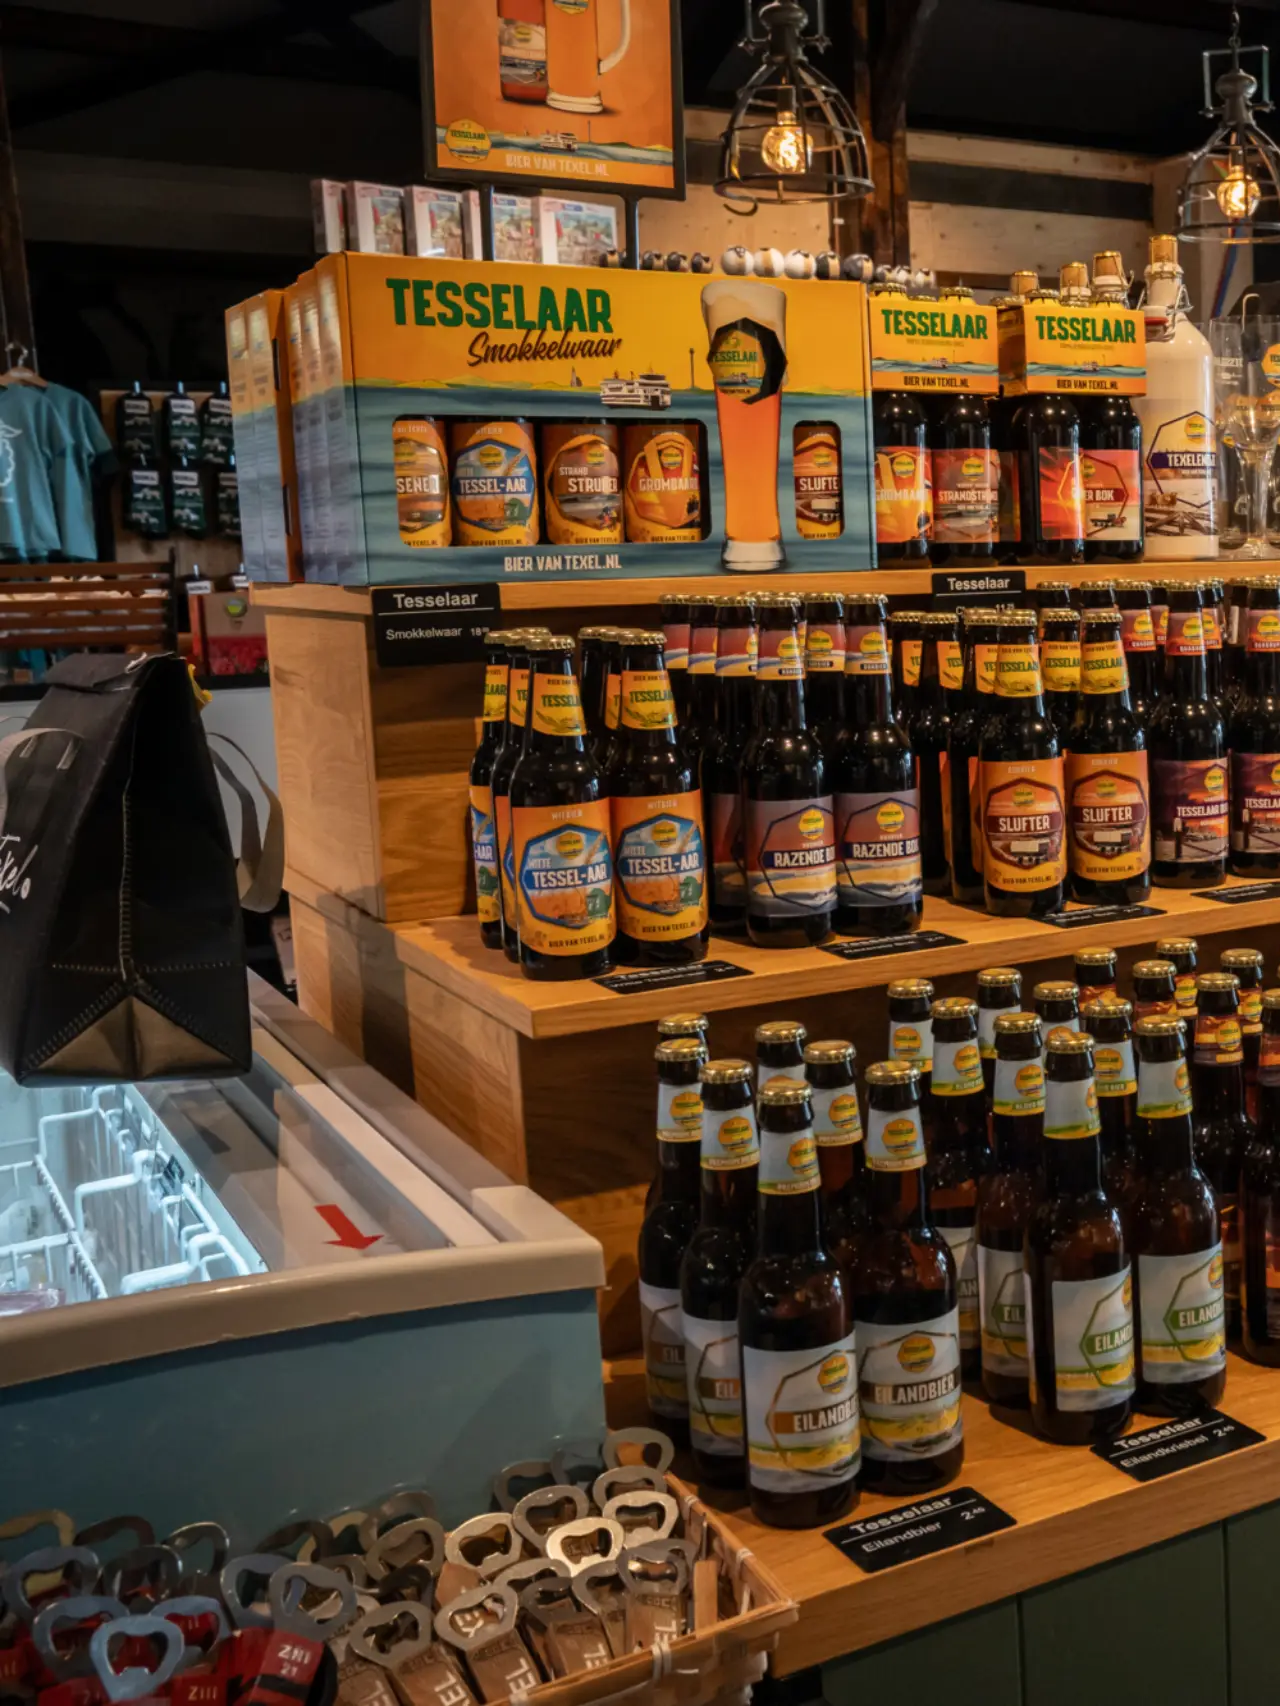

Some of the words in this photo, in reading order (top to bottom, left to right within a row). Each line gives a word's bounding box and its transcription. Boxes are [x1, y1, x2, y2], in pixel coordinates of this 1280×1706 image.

[505, 152, 532, 169] BIER
[534, 155, 558, 172] VAN
[559, 157, 610, 177] TEXEL.NL
[386, 278, 613, 333] TESSELAAR
[881, 309, 988, 340] TESSELAAR
[1036, 315, 1137, 343] TESSELAAR
[467, 327, 622, 367] Smokkelwaar
[904, 375, 920, 387] BIER
[921, 376, 936, 387] VAN
[937, 376, 970, 388] TEXEL.NL
[1057, 378, 1071, 389] BIER
[1073, 379, 1087, 390] VAN
[1088, 379, 1119, 391] TEXEL.NL
[459, 477, 527, 494] TESSEL-AAR
[504, 556, 533, 573] BIER
[536, 555, 563, 572] VAN
[565, 554, 622, 571] TEXEL.NL
[947, 576, 1010, 592] Tesselaar
[393, 591, 478, 610] Tesselaar
[386, 626, 463, 641] Smokkelwaar
[1083, 805, 1133, 823] SLUFTER
[1177, 804, 1219, 817] TESSELAAR
[999, 815, 1050, 832] SLUFTER
[774, 849, 825, 867] RAZENDE
[852, 841, 904, 858] RAZENDE
[628, 853, 700, 875] TESSEL-AAR
[532, 864, 607, 889] TESSEL-AAR
[714, 1380, 741, 1399] EIL
[874, 1374, 955, 1404] EILANDBIER
[1113, 1416, 1203, 1449] Tesselaar
[849, 1497, 952, 1534] Tesselaar
[861, 1521, 942, 1553] Eilandbier
